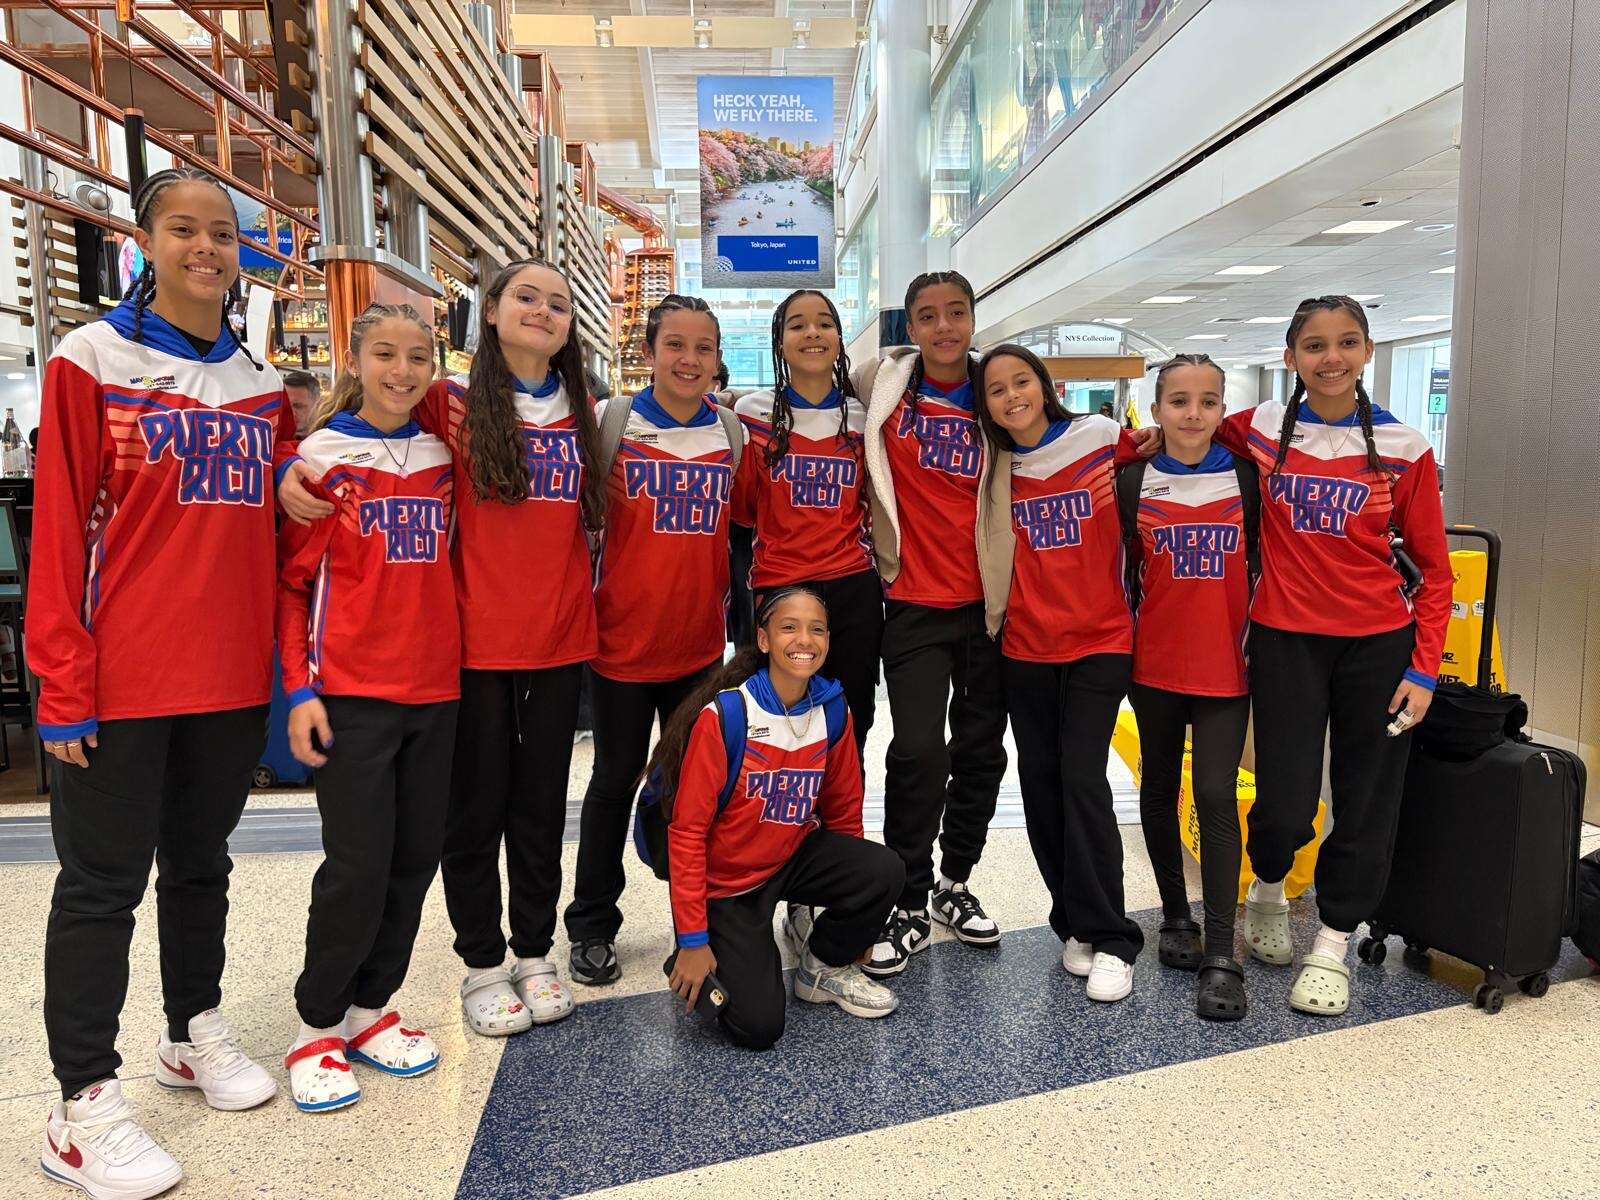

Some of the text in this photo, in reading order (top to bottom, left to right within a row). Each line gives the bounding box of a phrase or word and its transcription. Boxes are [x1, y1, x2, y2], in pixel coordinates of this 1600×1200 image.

[713, 94, 805, 109] HECK YEAH,
[713, 109, 818, 122] WE FLY THERE.
[750, 241, 787, 249] Tokyo, Japan
[1434, 396, 1442, 406] 2
[137, 408, 273, 467] PUERTO
[917, 439, 983, 479] RICO
[178, 456, 265, 507] RICO
[623, 458, 733, 504] PUERTO
[790, 481, 843, 509] RICO
[1267, 472, 1372, 517] PUERTO
[358, 495, 447, 537] PUERTO
[653, 496, 723, 535] RICO
[1290, 503, 1349, 539] RICO
[385, 528, 439, 564] RICO
[1027, 517, 1083, 552] RICO
[1151, 522, 1241, 555] PUERTO
[1171, 549, 1225, 580] RICO
[758, 793, 814, 827] RICO
[1188, 803, 1197, 835] PISO
